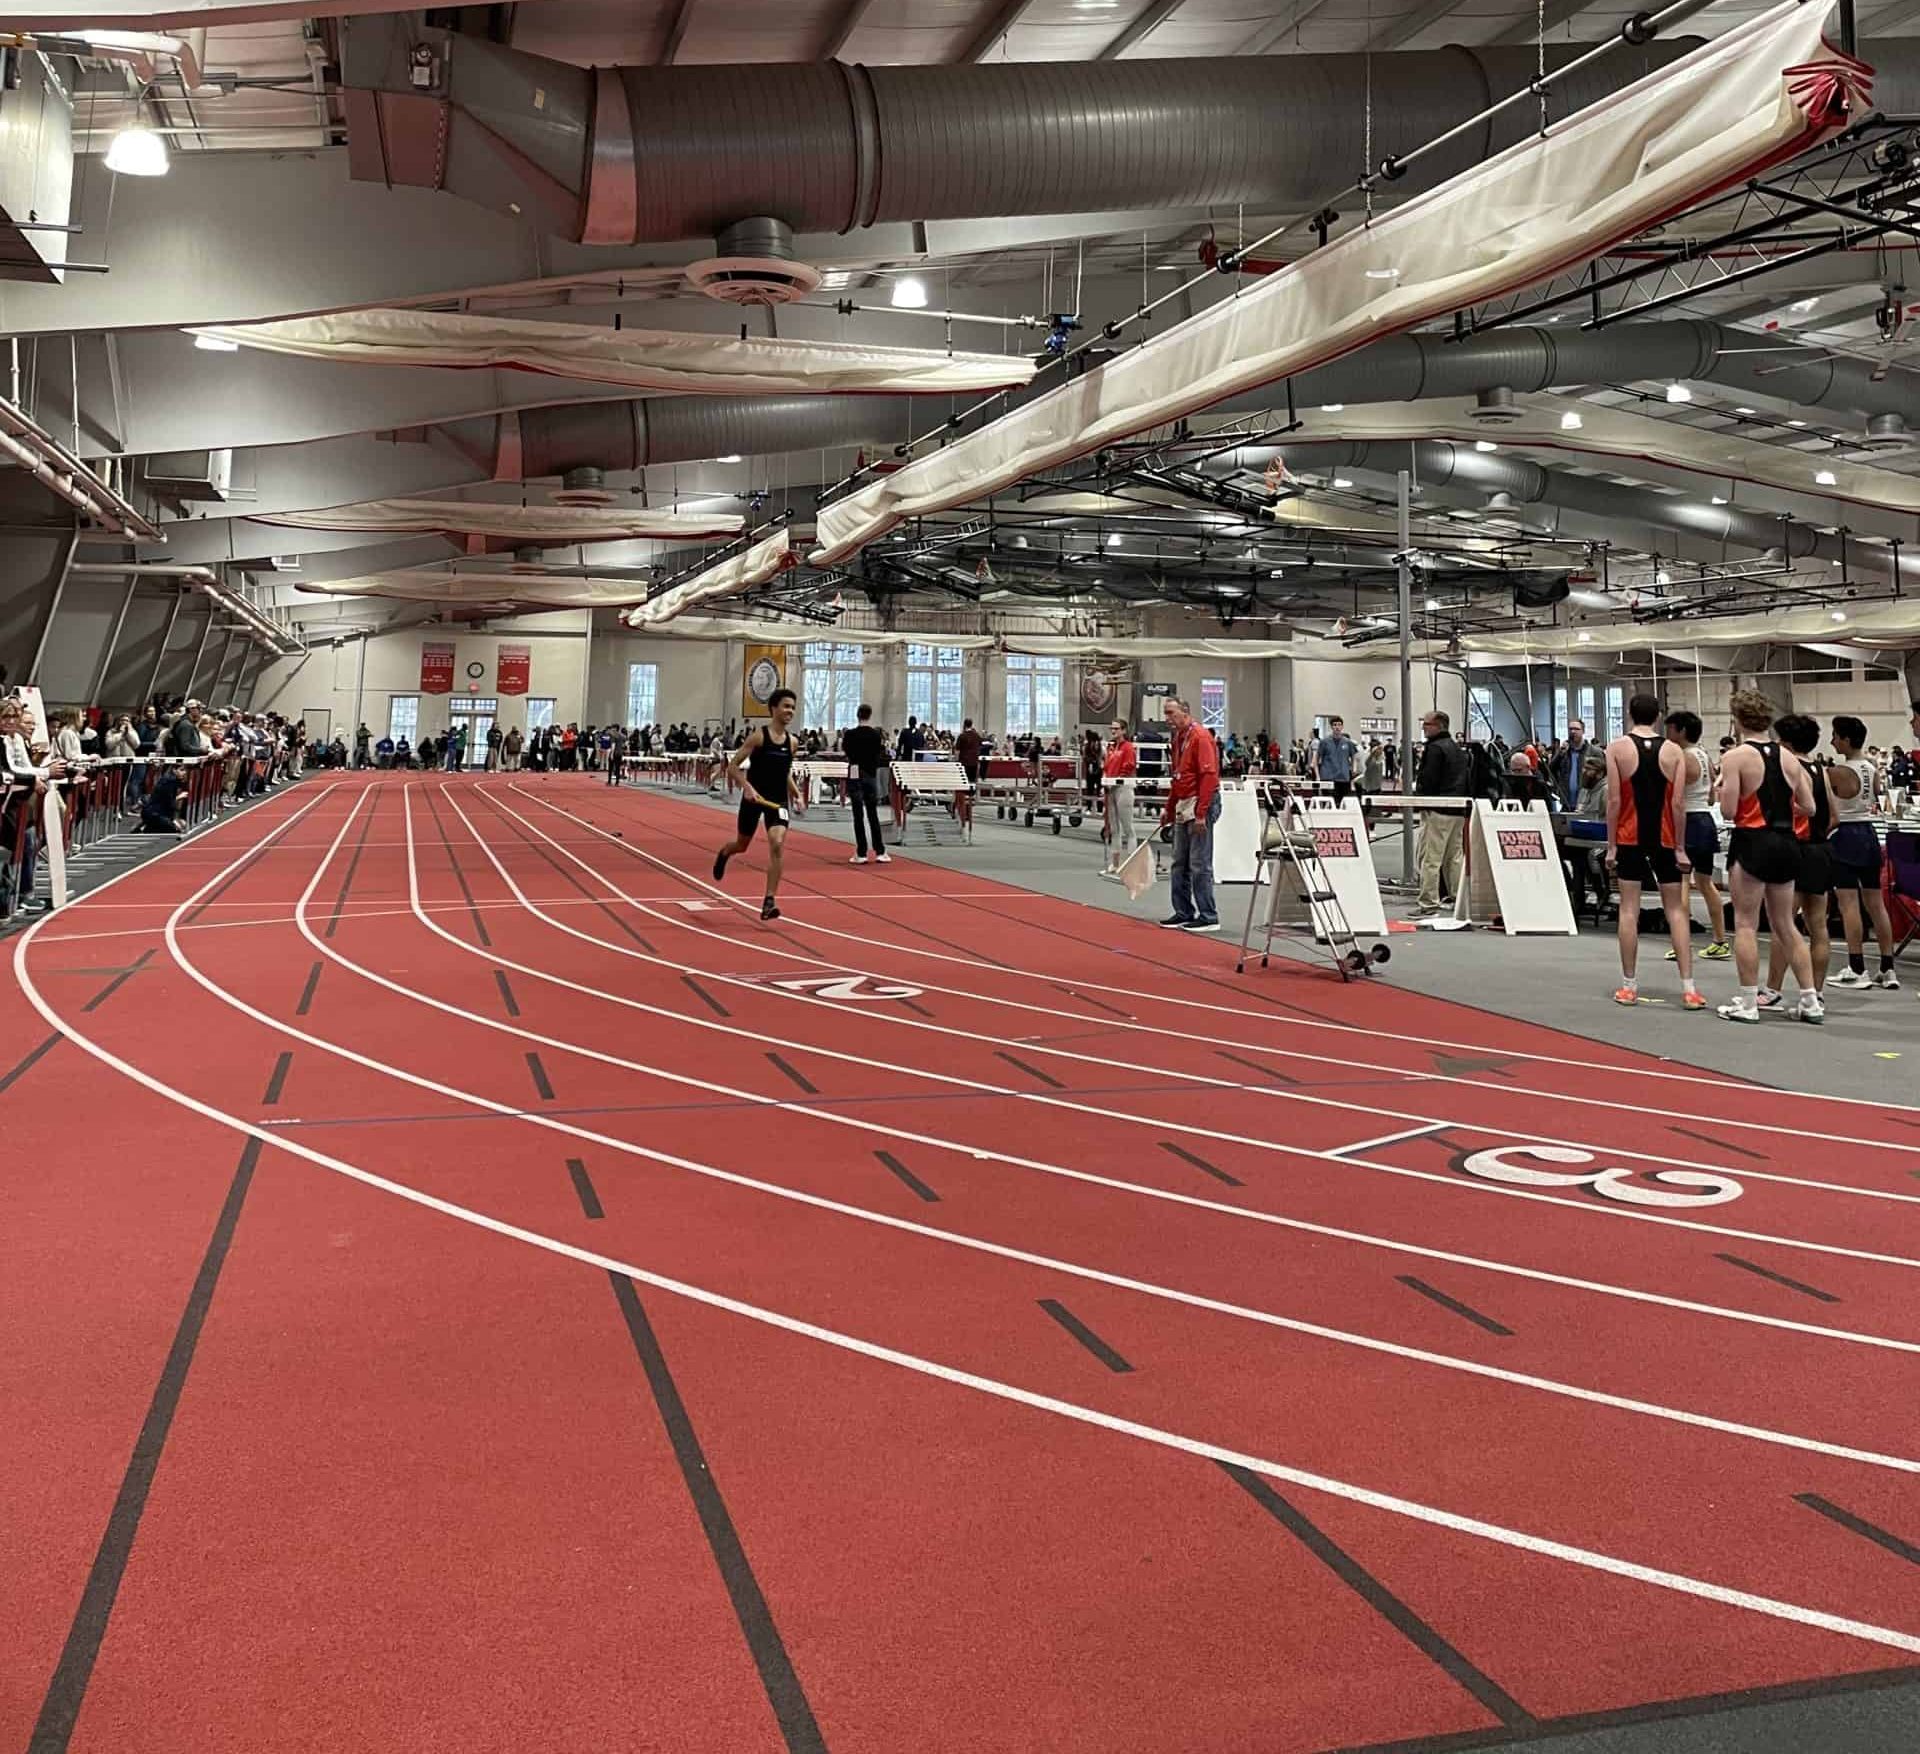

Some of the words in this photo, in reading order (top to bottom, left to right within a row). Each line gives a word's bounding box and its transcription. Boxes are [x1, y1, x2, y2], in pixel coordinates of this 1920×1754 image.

[1328, 829, 1353, 842] NOT
[1499, 832, 1516, 845] DO
[1516, 832, 1541, 845] NOT
[1316, 843, 1356, 856] ENTER
[1503, 845, 1544, 858] ENTER
[769, 975, 924, 1000] 2
[1462, 1145, 1744, 1208] 3
